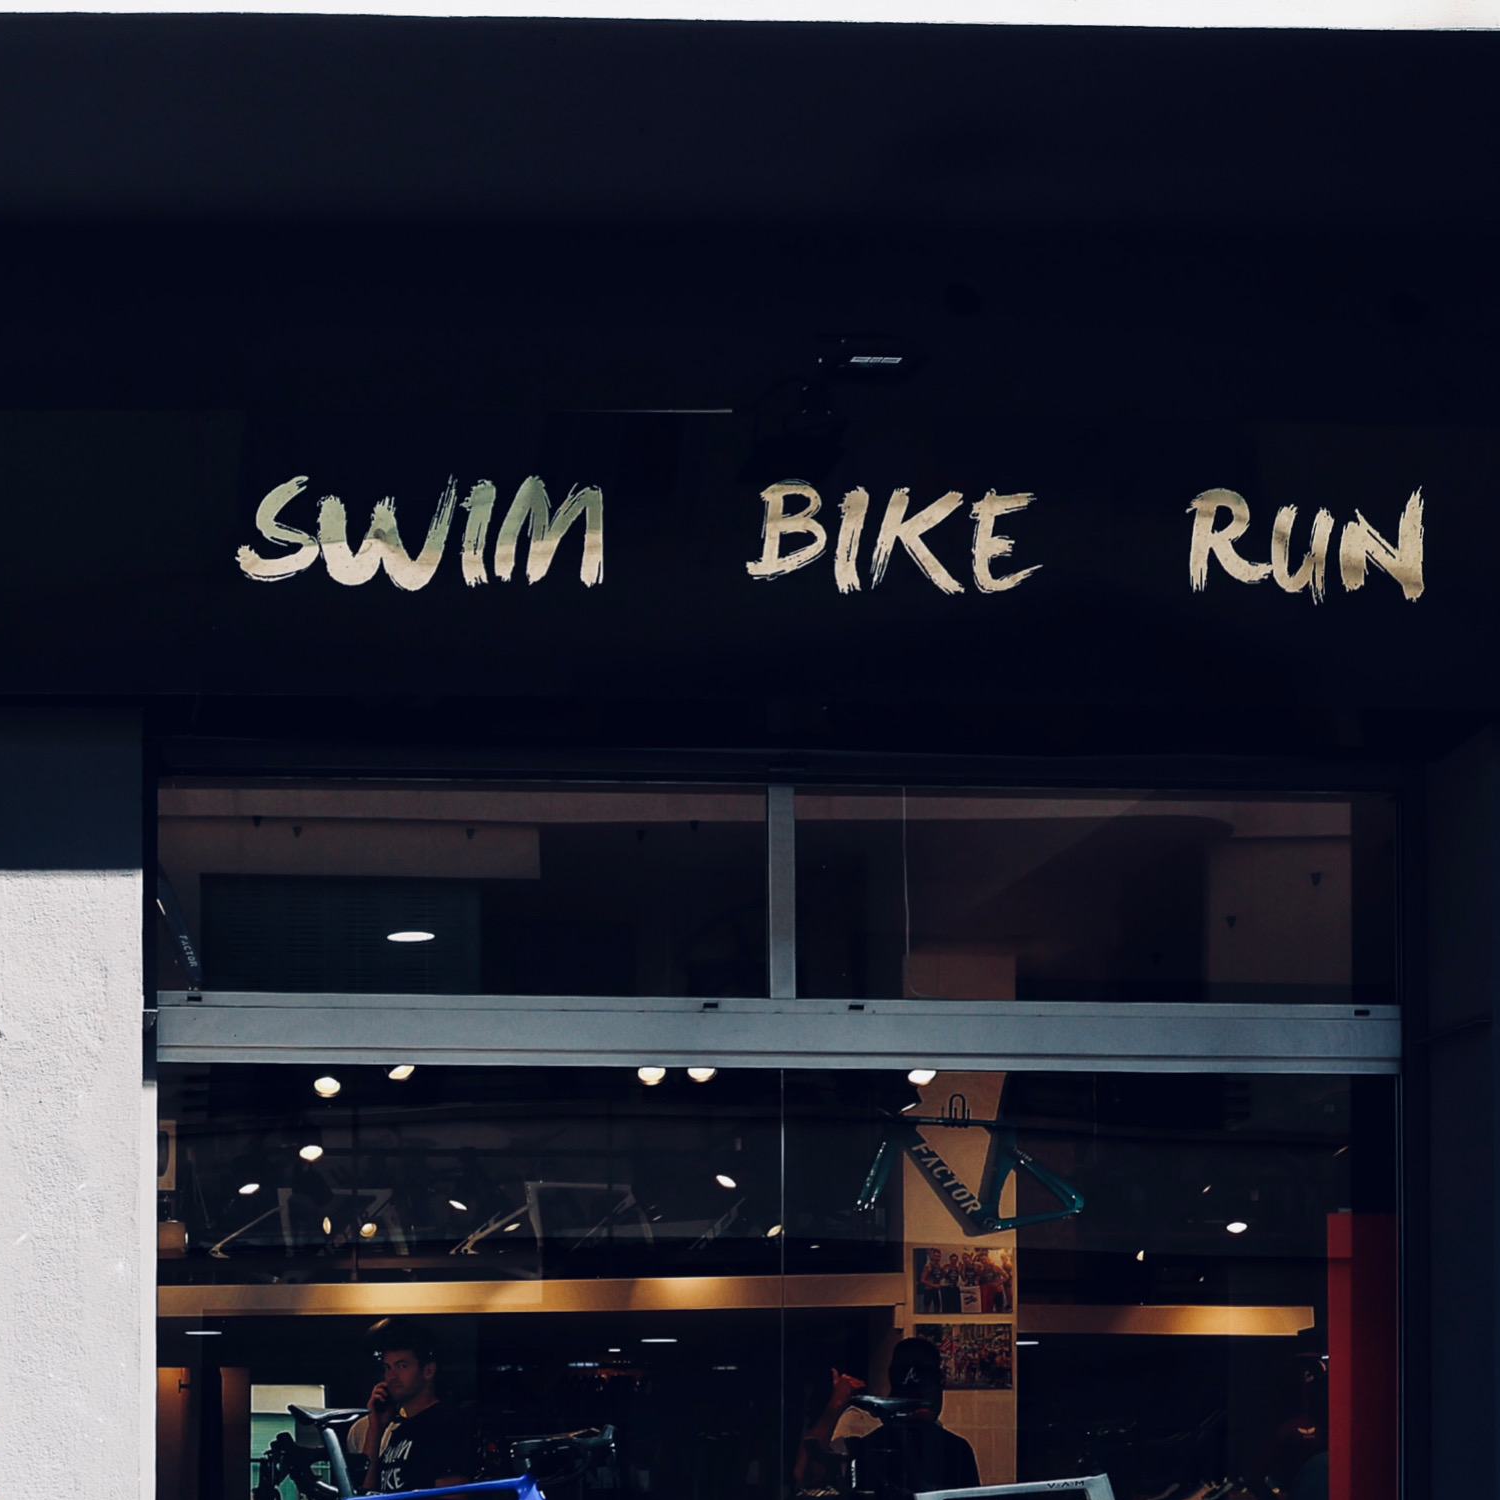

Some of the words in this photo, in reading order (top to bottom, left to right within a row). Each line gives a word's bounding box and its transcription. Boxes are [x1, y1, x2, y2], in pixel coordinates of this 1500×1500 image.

[235, 475, 604, 592] SWIM
[746, 483, 1043, 595] BIKE
[1186, 485, 1425, 605] RUN
[179, 935, 198, 968] FACTOR
[911, 1141, 982, 1216] FACTOR
